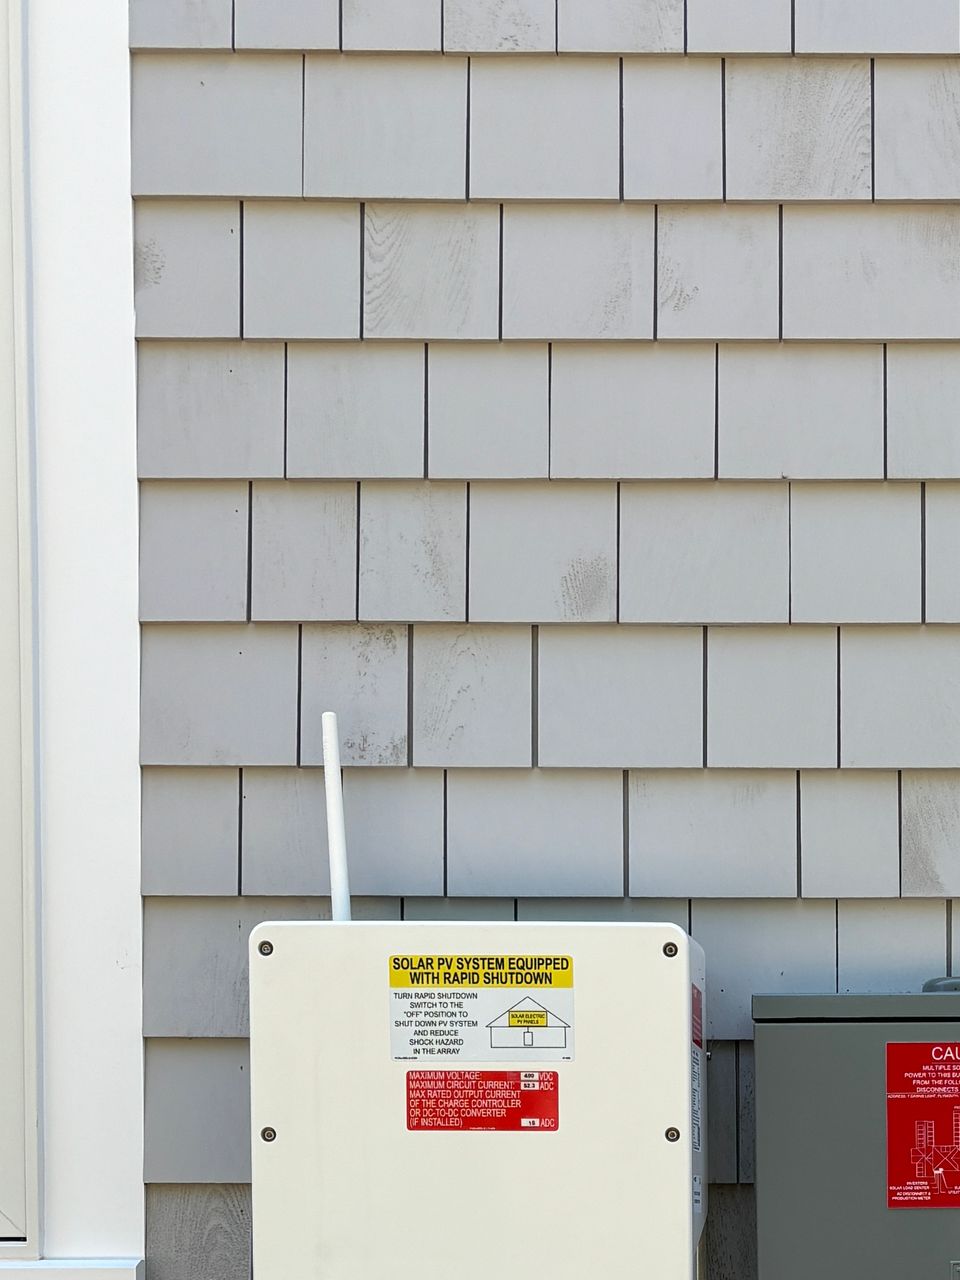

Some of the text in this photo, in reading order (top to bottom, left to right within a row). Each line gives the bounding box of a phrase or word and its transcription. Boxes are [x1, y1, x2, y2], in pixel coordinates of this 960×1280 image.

[393, 957, 569, 970] SOLAR PV SYSTEM EQUIPPED
[410, 972, 552, 985] WITH RAPID SHUTDOWN
[409, 1072, 444, 1080] MAXIMUM
[539, 1072, 553, 1081] VDC
[409, 1081, 445, 1089] MAXIMUM
[446, 1081, 476, 1089] CIRCUIT
[540, 1082, 554, 1091] ADC
[409, 1090, 521, 1099] MAX RATED OUTPUT CURRENT
[409, 1100, 521, 1108] OF THE CHARGE CONTROLLER
[409, 1109, 507, 1117] OR DC-TO-DC CONVERTER
[409, 1118, 555, 1127] (IF INSTALLED) ADC
